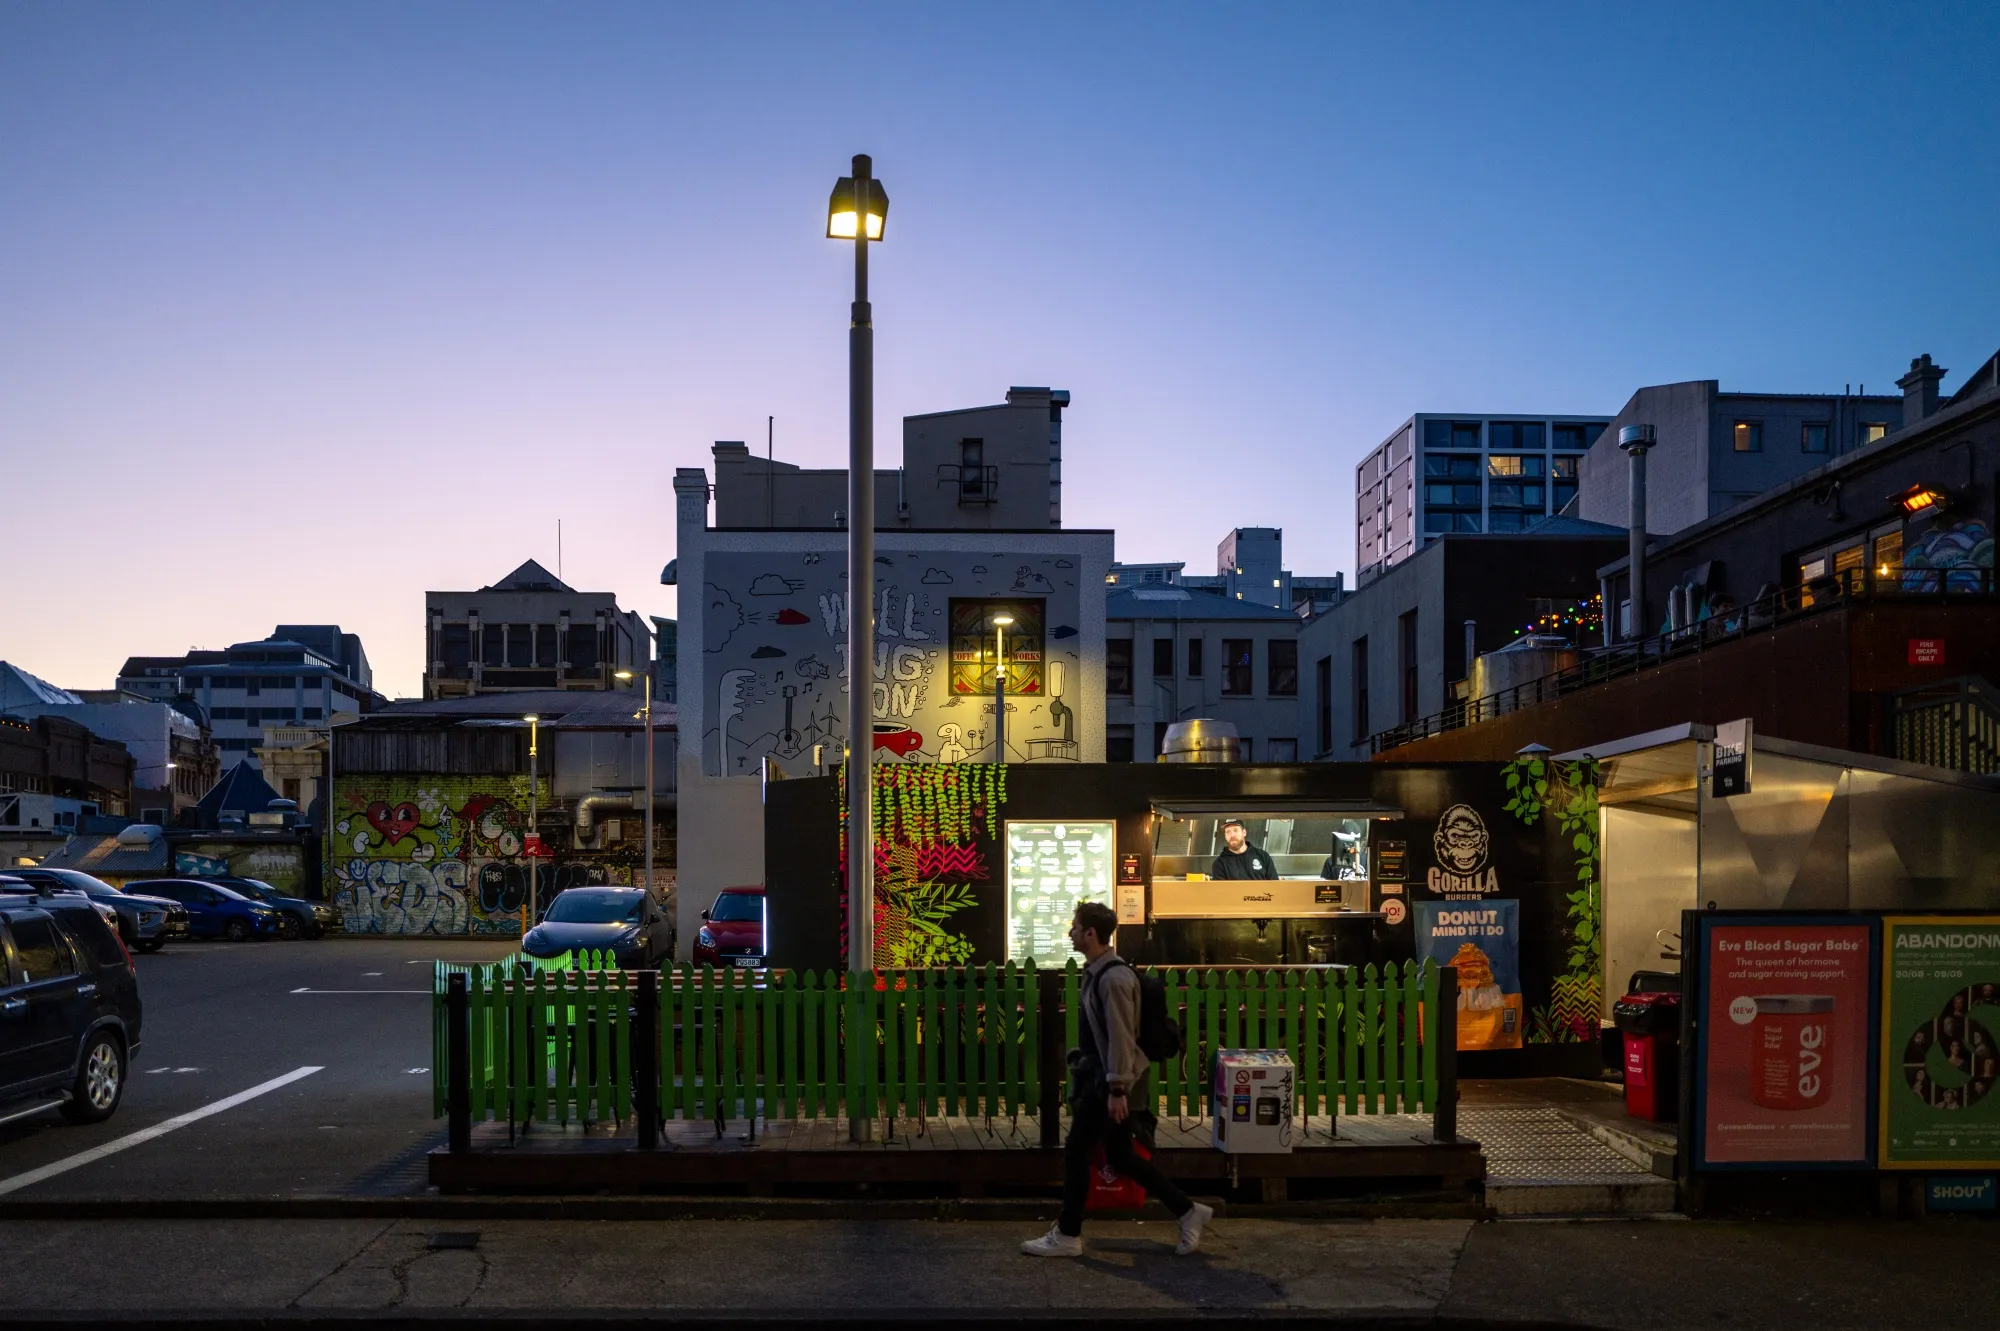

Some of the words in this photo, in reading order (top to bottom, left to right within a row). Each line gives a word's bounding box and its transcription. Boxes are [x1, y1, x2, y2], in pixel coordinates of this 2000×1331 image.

[818, 587, 930, 641] WLL
[1716, 741, 1743, 759] BIKE
[1716, 755, 1742, 767] PARKING
[1445, 893, 1482, 901] BURGERS
[1437, 910, 1498, 926] DONUT
[1431, 926, 1466, 937] MIND
[1468, 926, 1479, 936] IF
[1487, 925, 1504, 936] DO
[1718, 940, 1741, 952] Eve
[1744, 940, 1781, 951] Blood
[1784, 940, 1823, 954] Sugar
[1825, 940, 1859, 951] Babe
[1736, 957, 1753, 966] The
[1755, 959, 1784, 968] queen
[1786, 956, 1797, 966] of
[1798, 957, 1840, 966] hormone
[1728, 970, 1746, 979] and
[1748, 971, 1773, 980] sugar
[1774, 970, 1808, 980] craving
[1809, 970, 1847, 980] support.
[1732, 1006, 1754, 1015] NEW
[1797, 1025, 1822, 1098] eve
[1932, 1185, 1985, 1199] SHOUT
